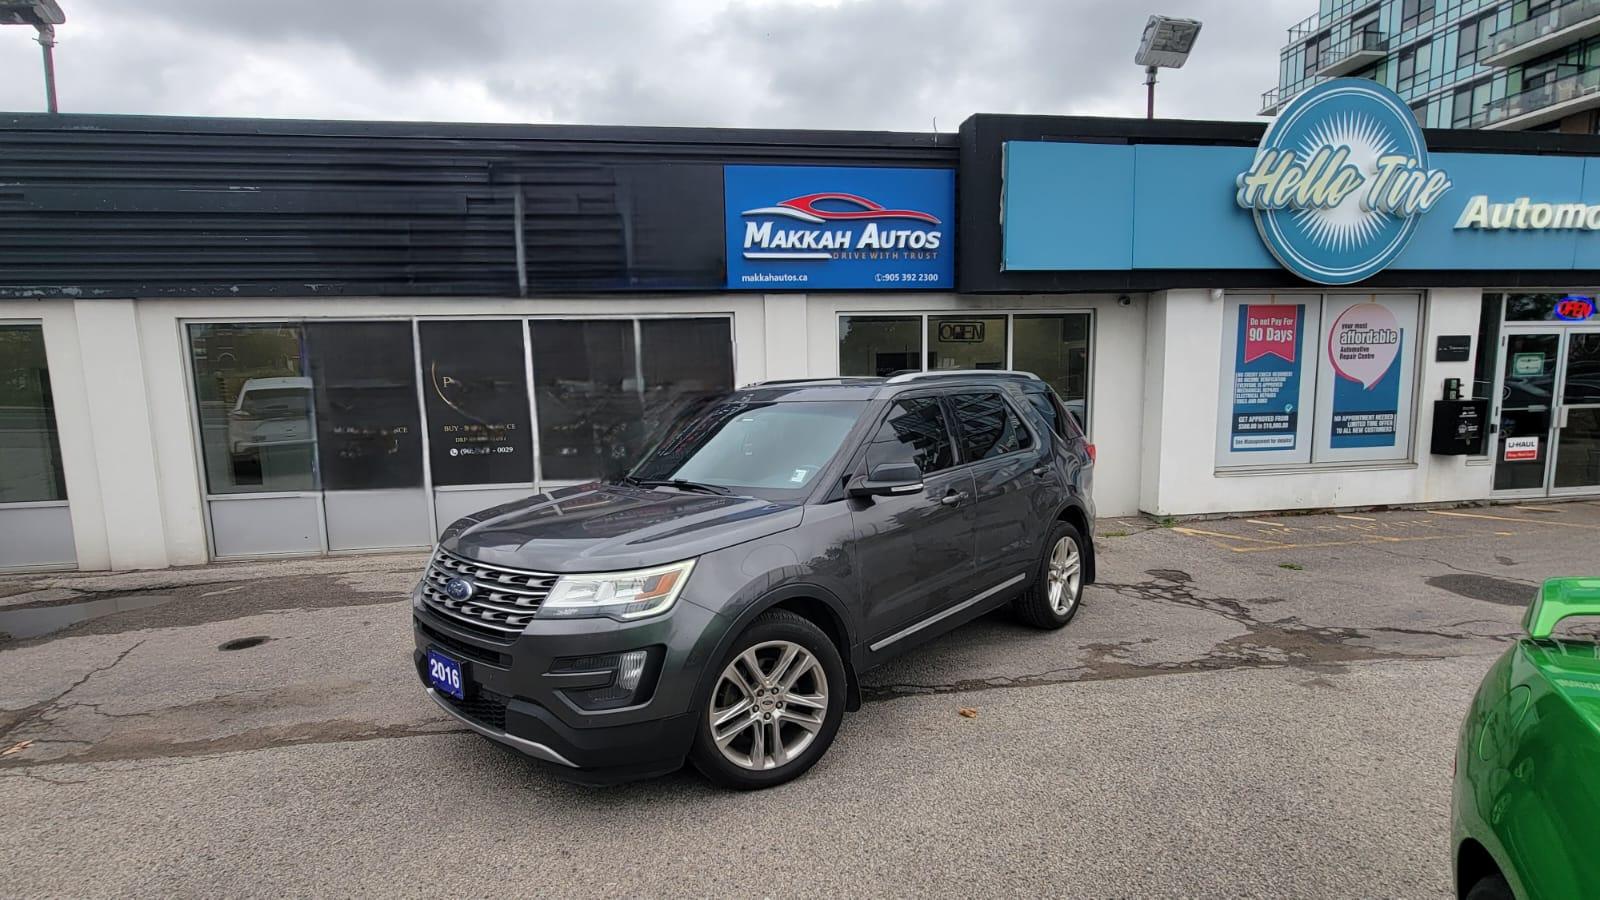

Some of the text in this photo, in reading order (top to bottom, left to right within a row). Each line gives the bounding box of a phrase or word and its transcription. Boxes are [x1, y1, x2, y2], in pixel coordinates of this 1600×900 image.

[1238, 144, 1454, 216] Hello Tire
[743, 221, 941, 249] MAKKAH AUTOS
[832, 251, 938, 260] DRIVE WITH TRUST
[741, 273, 808, 282] makkahautos.ca
[901, 273, 917, 281] 392
[918, 273, 939, 281] 2300
[1558, 301, 1592, 318] OPEN
[1271, 318, 1282, 326] Pay
[1283, 317, 1294, 325] For
[941, 325, 983, 339] OPEN
[1249, 327, 1293, 343] 90 Days
[1340, 329, 1398, 345] affordable
[1249, 415, 1274, 423] APPROVED
[1508, 440, 1536, 448] U-HAUL
[430, 658, 460, 689] 2016
